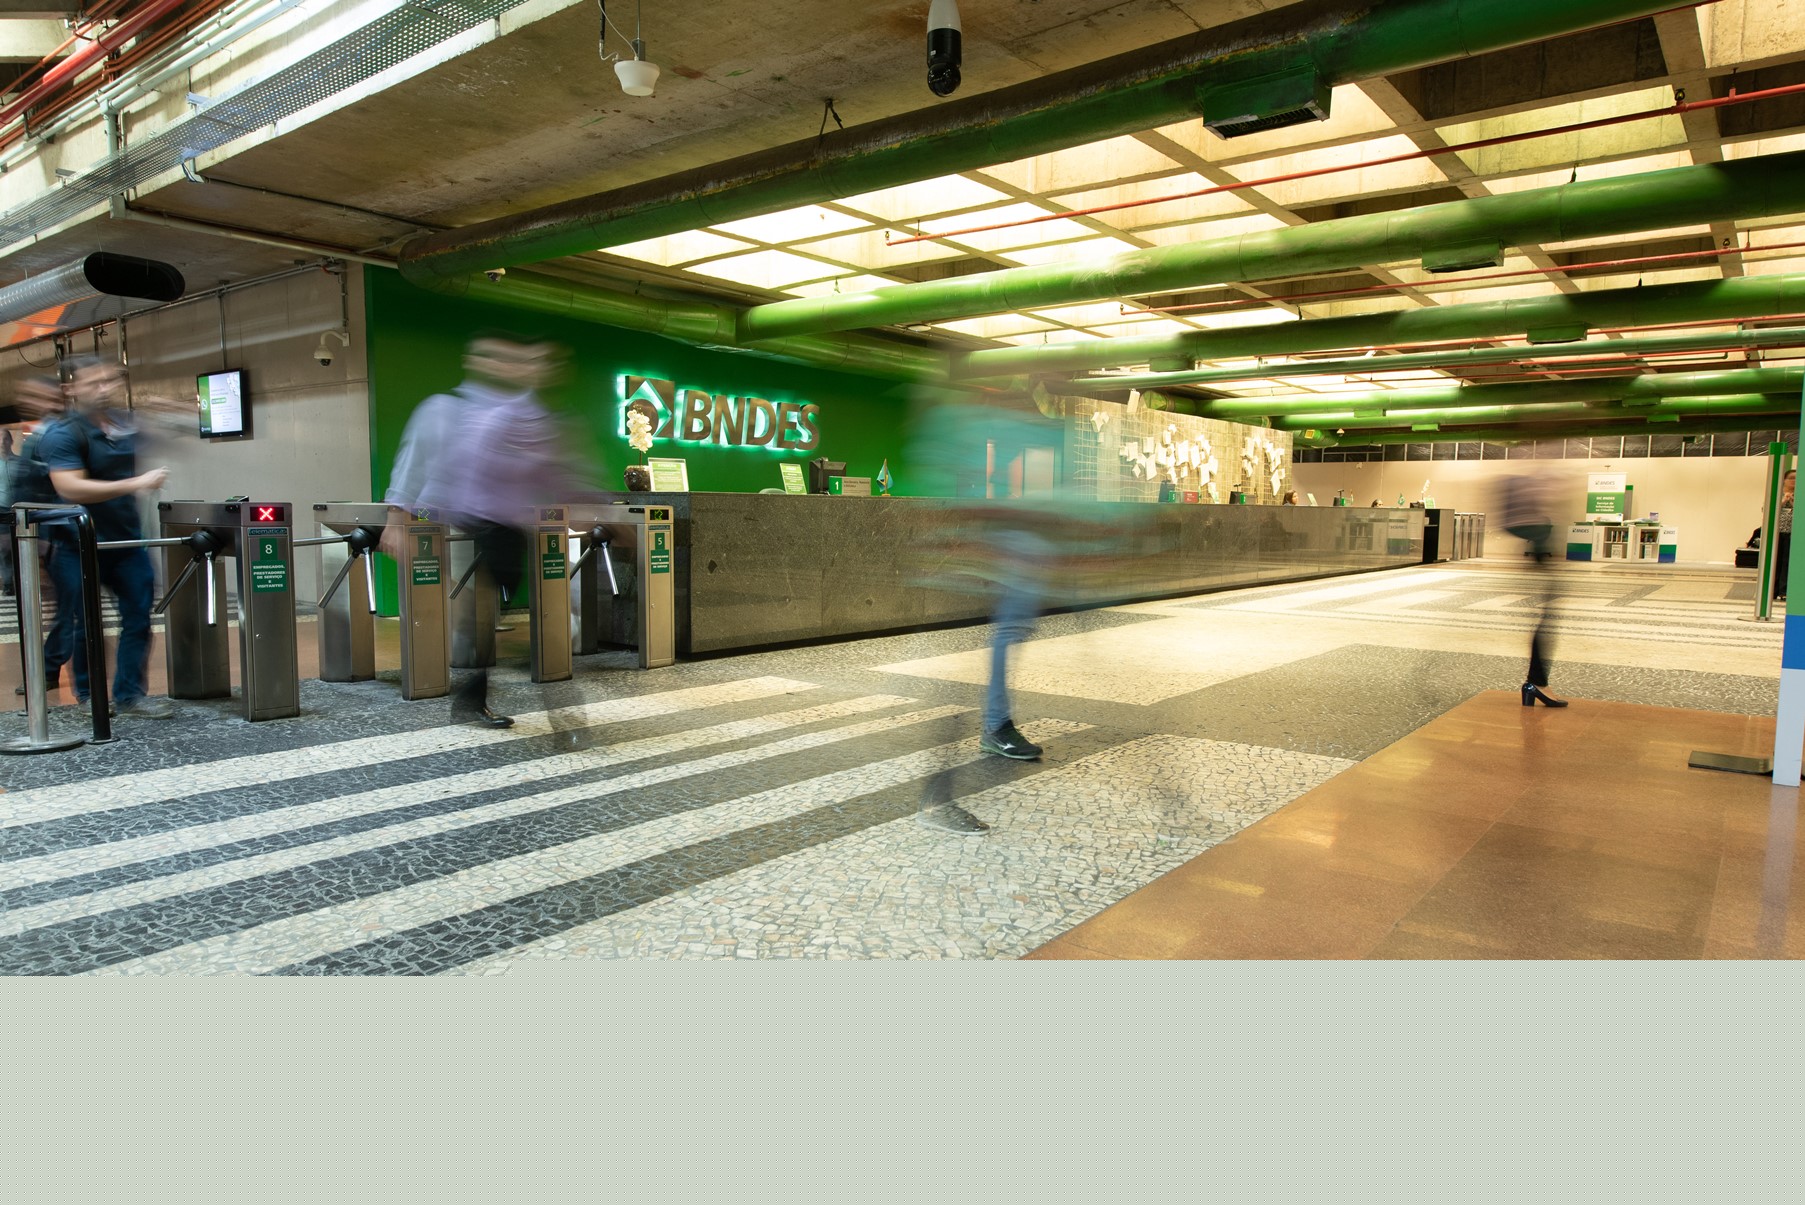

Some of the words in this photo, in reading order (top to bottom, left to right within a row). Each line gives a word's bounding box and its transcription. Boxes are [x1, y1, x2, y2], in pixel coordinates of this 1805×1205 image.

[682, 389, 820, 451] BNDES
[834, 481, 839, 490] 1
[422, 541, 428, 550] 7
[551, 540, 556, 548] 6
[658, 537, 662, 546] 5
[265, 544, 273, 554] 8
